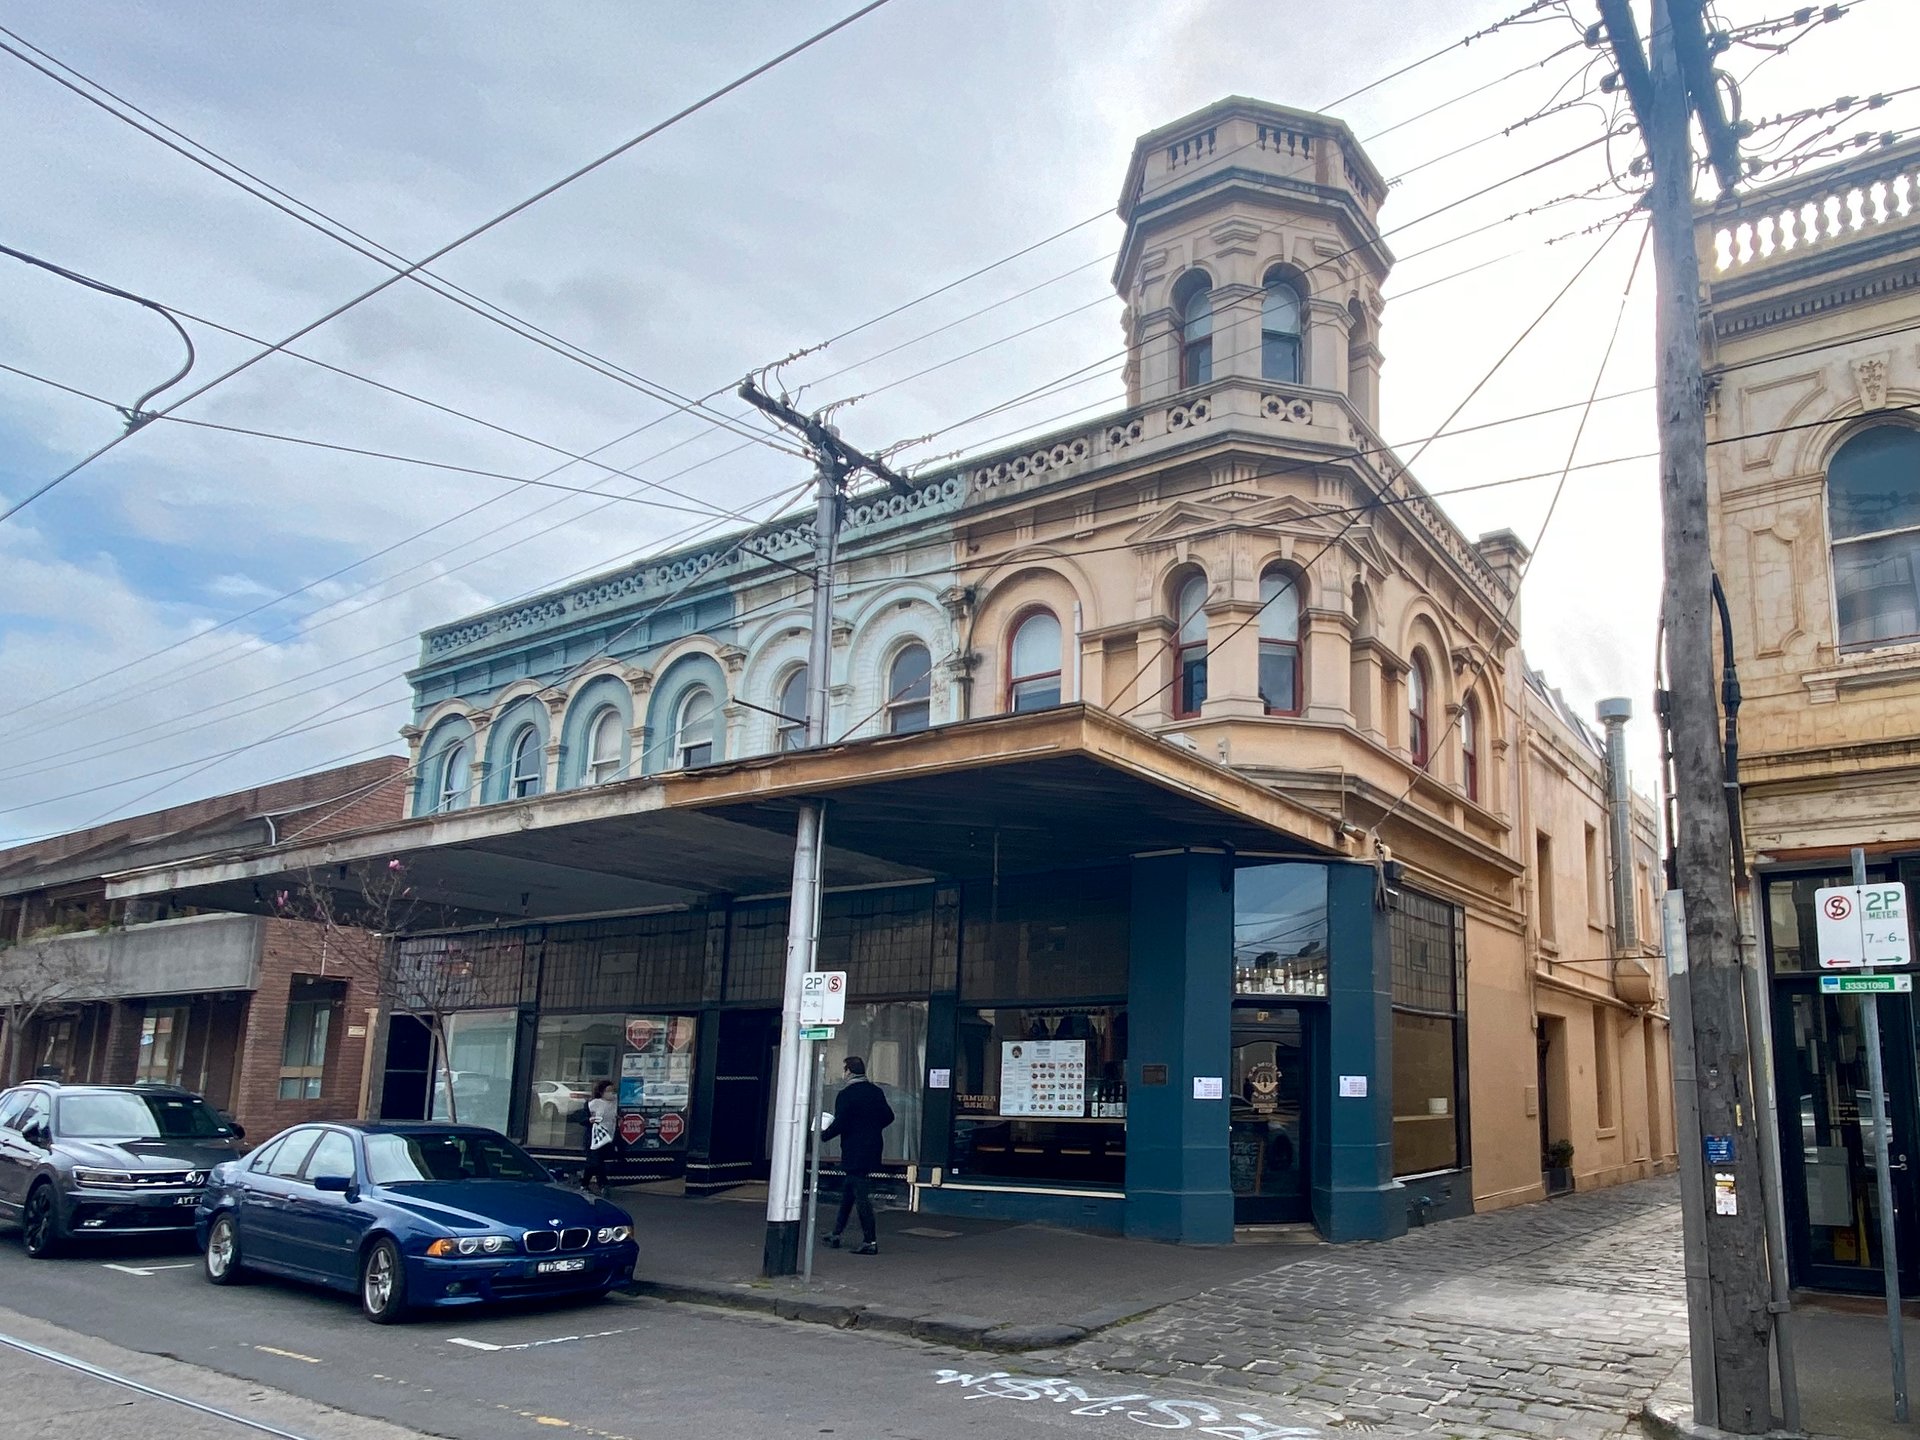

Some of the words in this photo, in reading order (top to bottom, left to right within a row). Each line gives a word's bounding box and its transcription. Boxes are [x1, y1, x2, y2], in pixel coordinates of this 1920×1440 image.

[1865, 891, 1901, 911] 2P
[1868, 910, 1899, 919] METER
[804, 977, 823, 989] 2P
